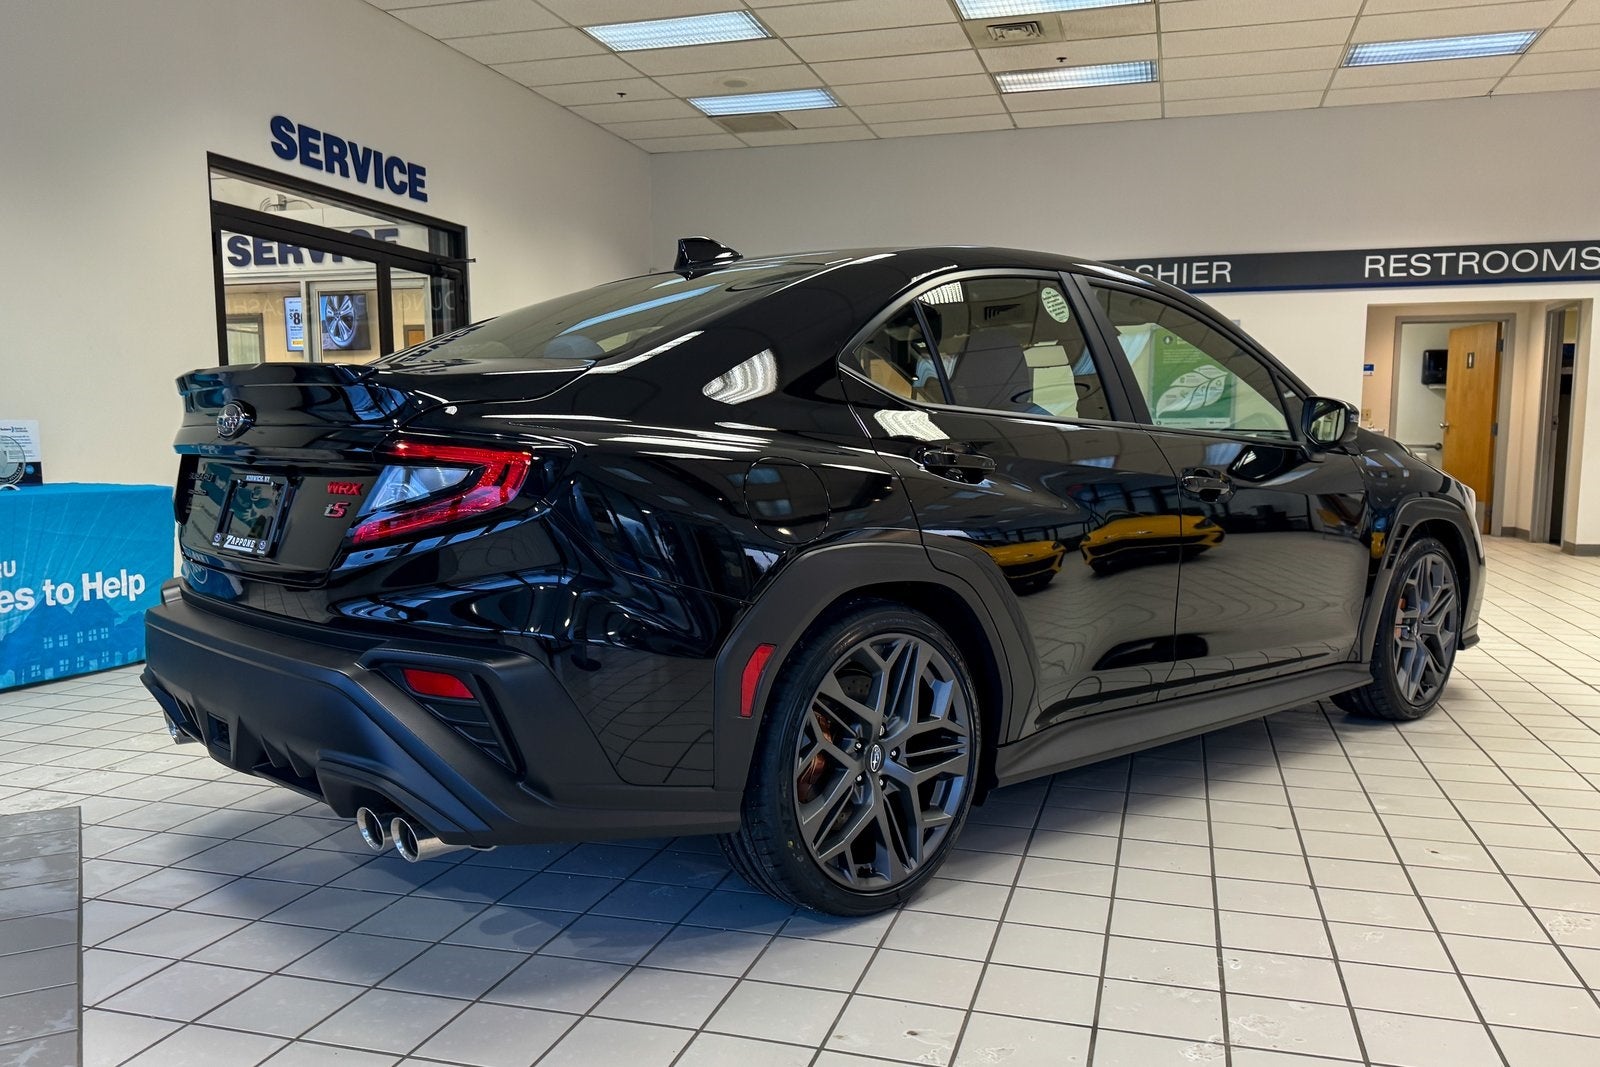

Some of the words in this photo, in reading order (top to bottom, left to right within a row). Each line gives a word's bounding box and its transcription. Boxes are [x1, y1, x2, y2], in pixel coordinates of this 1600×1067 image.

[270, 115, 428, 203] SERVICE
[1364, 246, 1600, 278] RESTROOMS
[327, 481, 363, 496] WRX
[223, 534, 256, 553] ZAPPONE
[42, 579, 75, 607] to
[81, 568, 146, 602] Help
